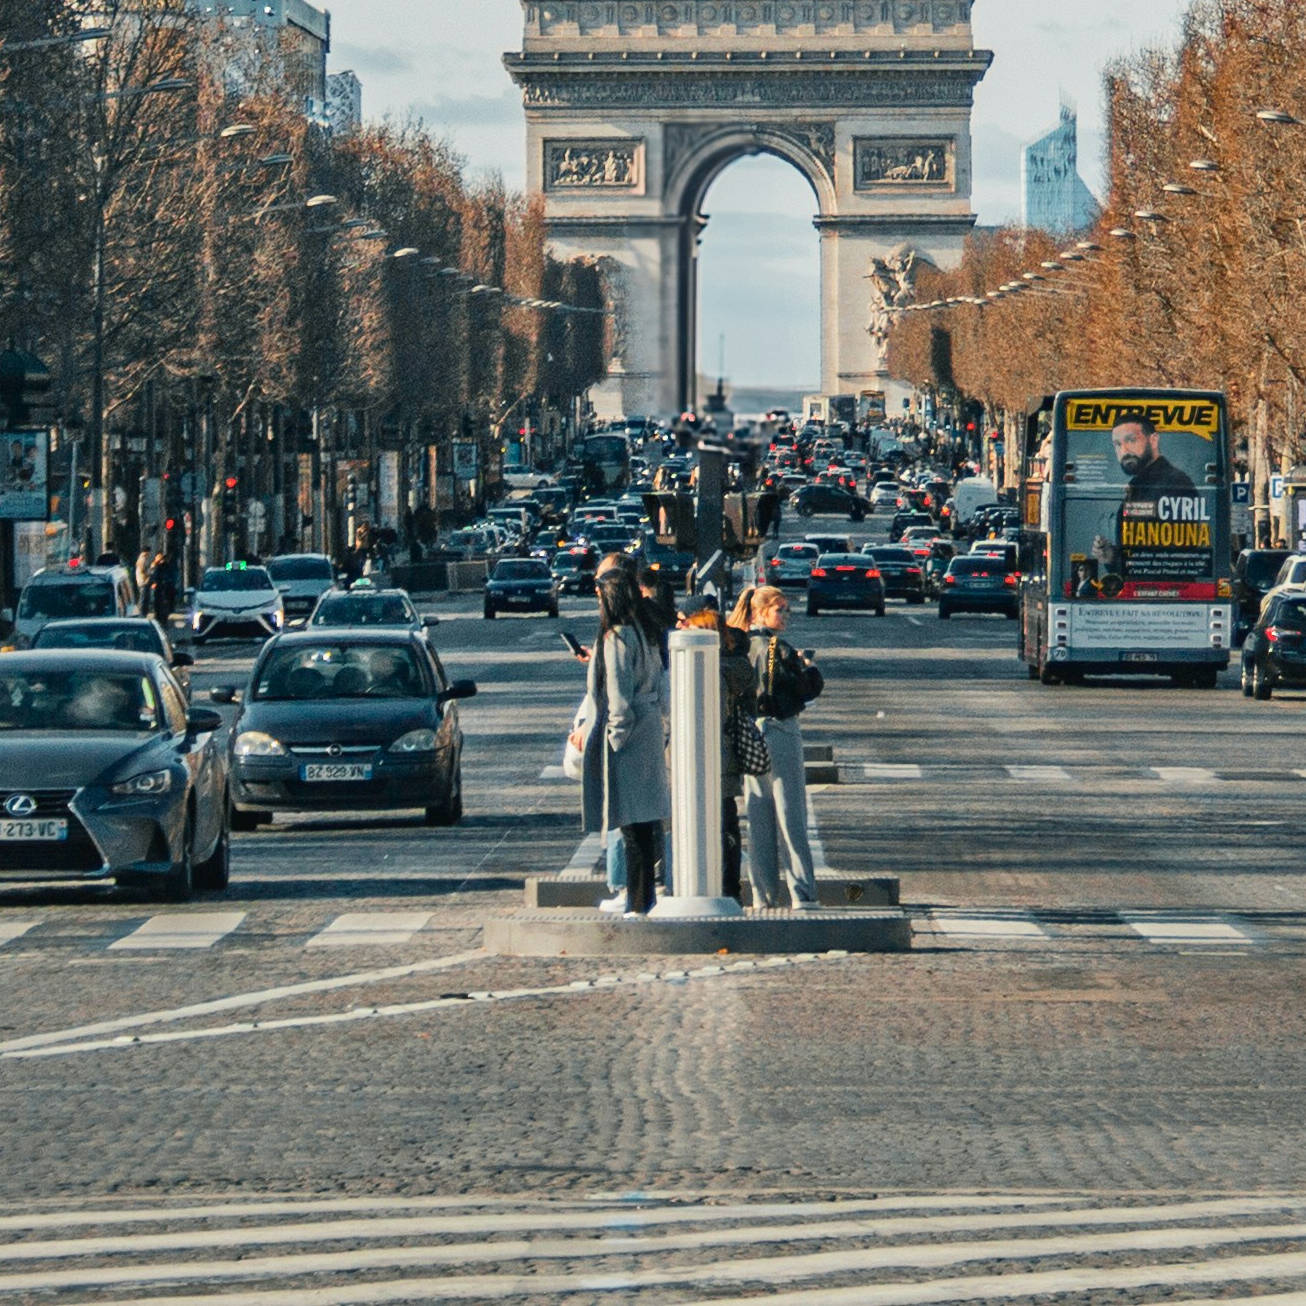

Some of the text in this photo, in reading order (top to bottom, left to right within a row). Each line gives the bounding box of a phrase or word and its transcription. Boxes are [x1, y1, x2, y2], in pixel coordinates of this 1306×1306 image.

[1237, 486, 1247, 499] P
[1158, 496, 1210, 521] CYRIL
[1122, 521, 1211, 546] HANOUNA
